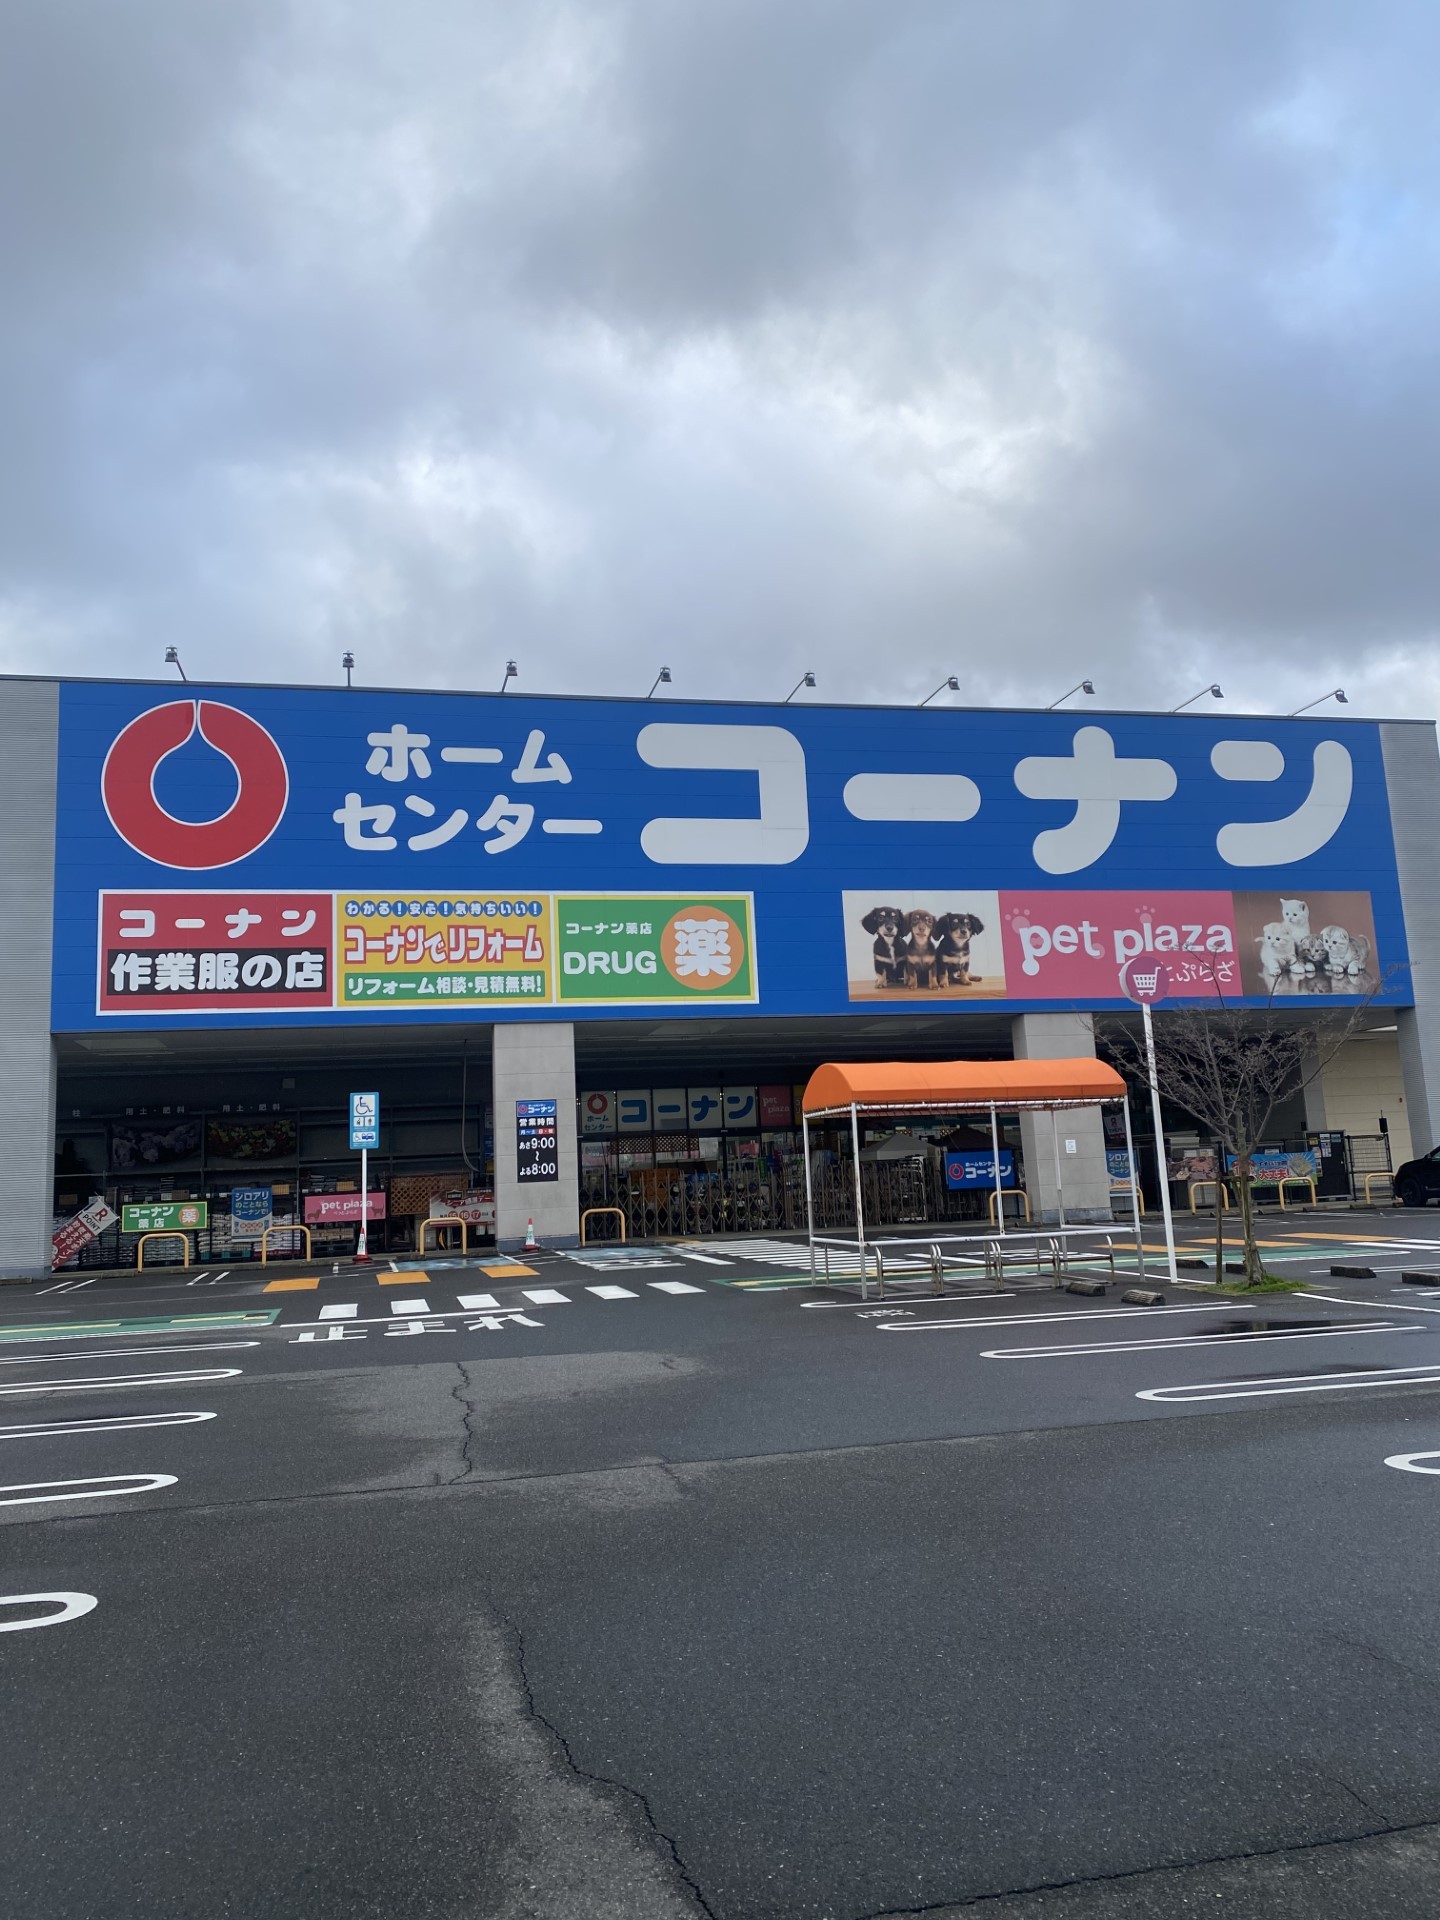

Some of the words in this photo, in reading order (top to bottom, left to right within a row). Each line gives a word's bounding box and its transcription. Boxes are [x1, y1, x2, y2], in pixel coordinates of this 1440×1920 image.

[366, 724, 572, 783] ホーム
[637, 722, 1353, 875] コーナン
[332, 792, 602, 854] センター
[119, 908, 317, 939] コーナン
[566, 922, 653, 935] コーナン薬店
[345, 925, 544, 964] コーナンでリフォーム
[674, 918, 732, 977] 薬
[1018, 920, 1101, 976] pet
[1113, 922, 1233, 964] plaza
[563, 950, 657, 975] DRUG
[110, 951, 324, 991] 作業服の店
[528, 1106, 555, 1114] コーナン
[621, 1095, 753, 1123] コーナン
[519, 1117, 554, 1127] 営業時間
[587, 1114, 609, 1123] ホーム
[584, 1123, 613, 1132] センター
[1108, 1153, 1129, 1161] シロア
[235, 1191, 269, 1201] シロアリ
[129, 1206, 174, 1218] コーナン
[235, 1201, 268, 1209] のことなら
[321, 1201, 341, 1214] pet
[95, 1207, 108, 1222] R
[181, 1208, 198, 1223] 薬
[82, 1214, 101, 1232] POINT
